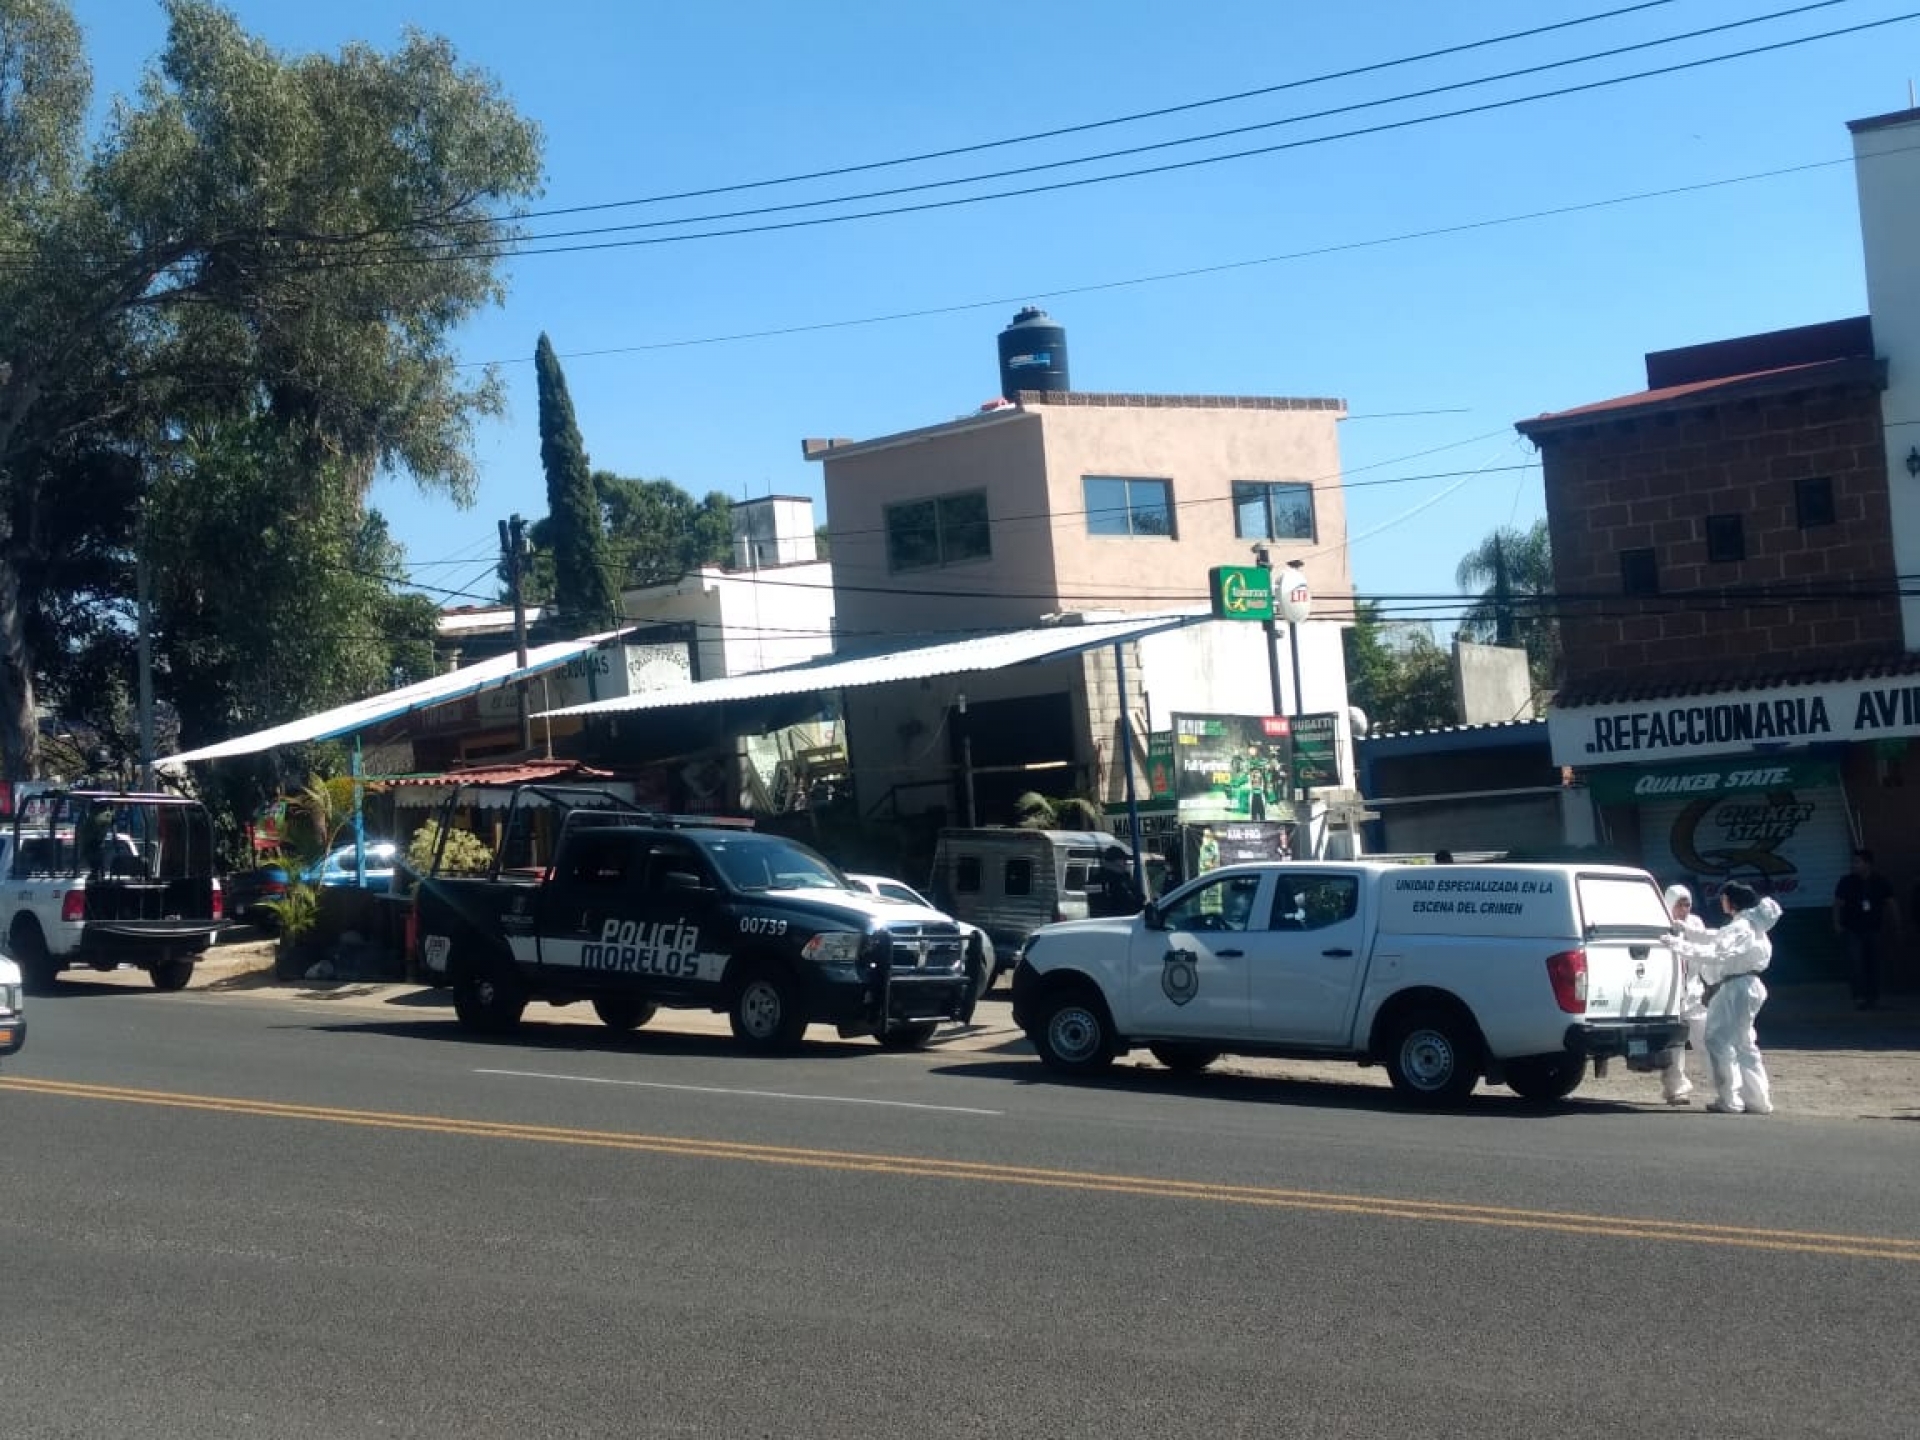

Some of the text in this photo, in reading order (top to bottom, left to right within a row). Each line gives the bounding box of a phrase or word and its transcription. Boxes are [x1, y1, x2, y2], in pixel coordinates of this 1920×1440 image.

[1594, 696, 1831, 753] REFACCIONARIA
[1634, 767, 1790, 795] QUAKER STATE
[1396, 879, 1553, 894] UNIDAD ESPECIALIZADA EN LA
[1412, 901, 1525, 915] ESCENA DEL CRIMEN
[739, 916, 788, 936] 00739
[580, 944, 700, 977] MORELOS
